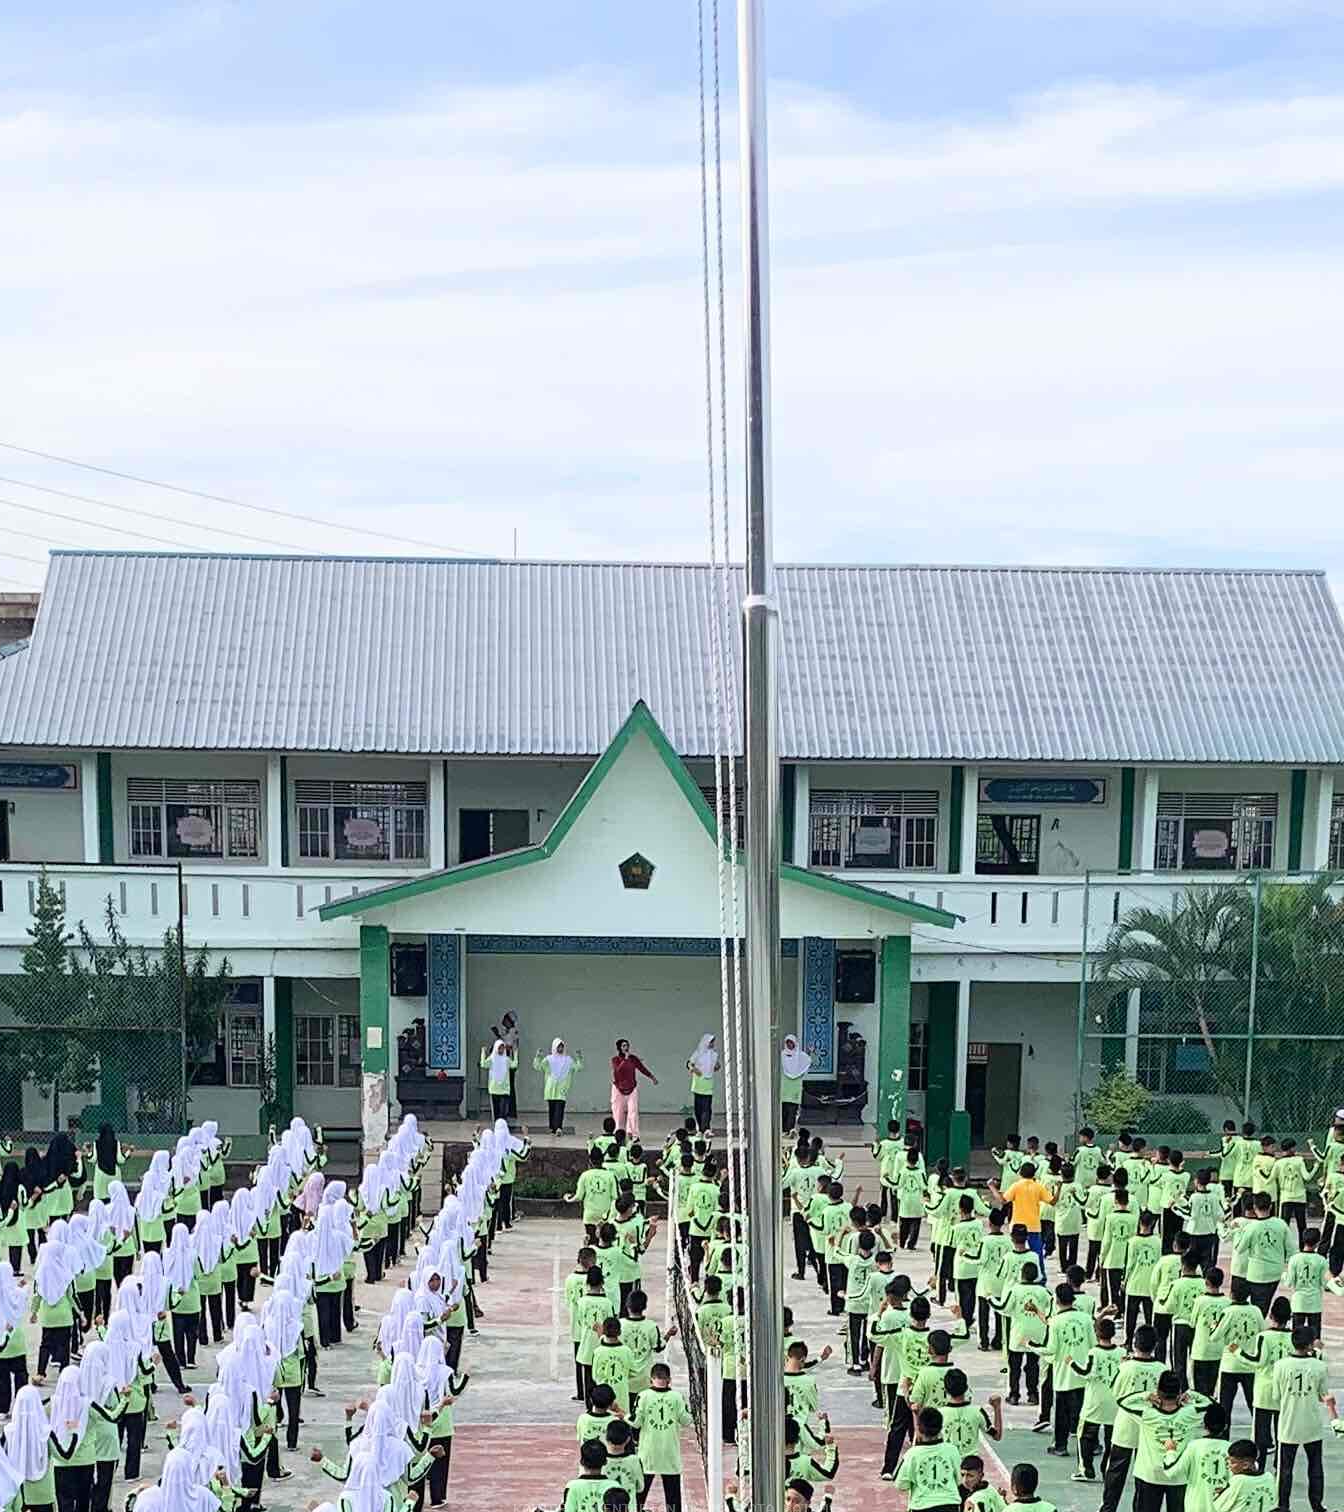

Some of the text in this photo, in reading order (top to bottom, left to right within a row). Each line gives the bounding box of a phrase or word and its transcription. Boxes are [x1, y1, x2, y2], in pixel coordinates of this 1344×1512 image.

[1296, 1373, 1302, 1391] 1
[658, 1406, 664, 1421] 1
[957, 1427, 961, 1441] 1
[932, 1463, 937, 1480] 1
[1214, 1459, 1219, 1475] 1
[1258, 1496, 1263, 1512] 1
